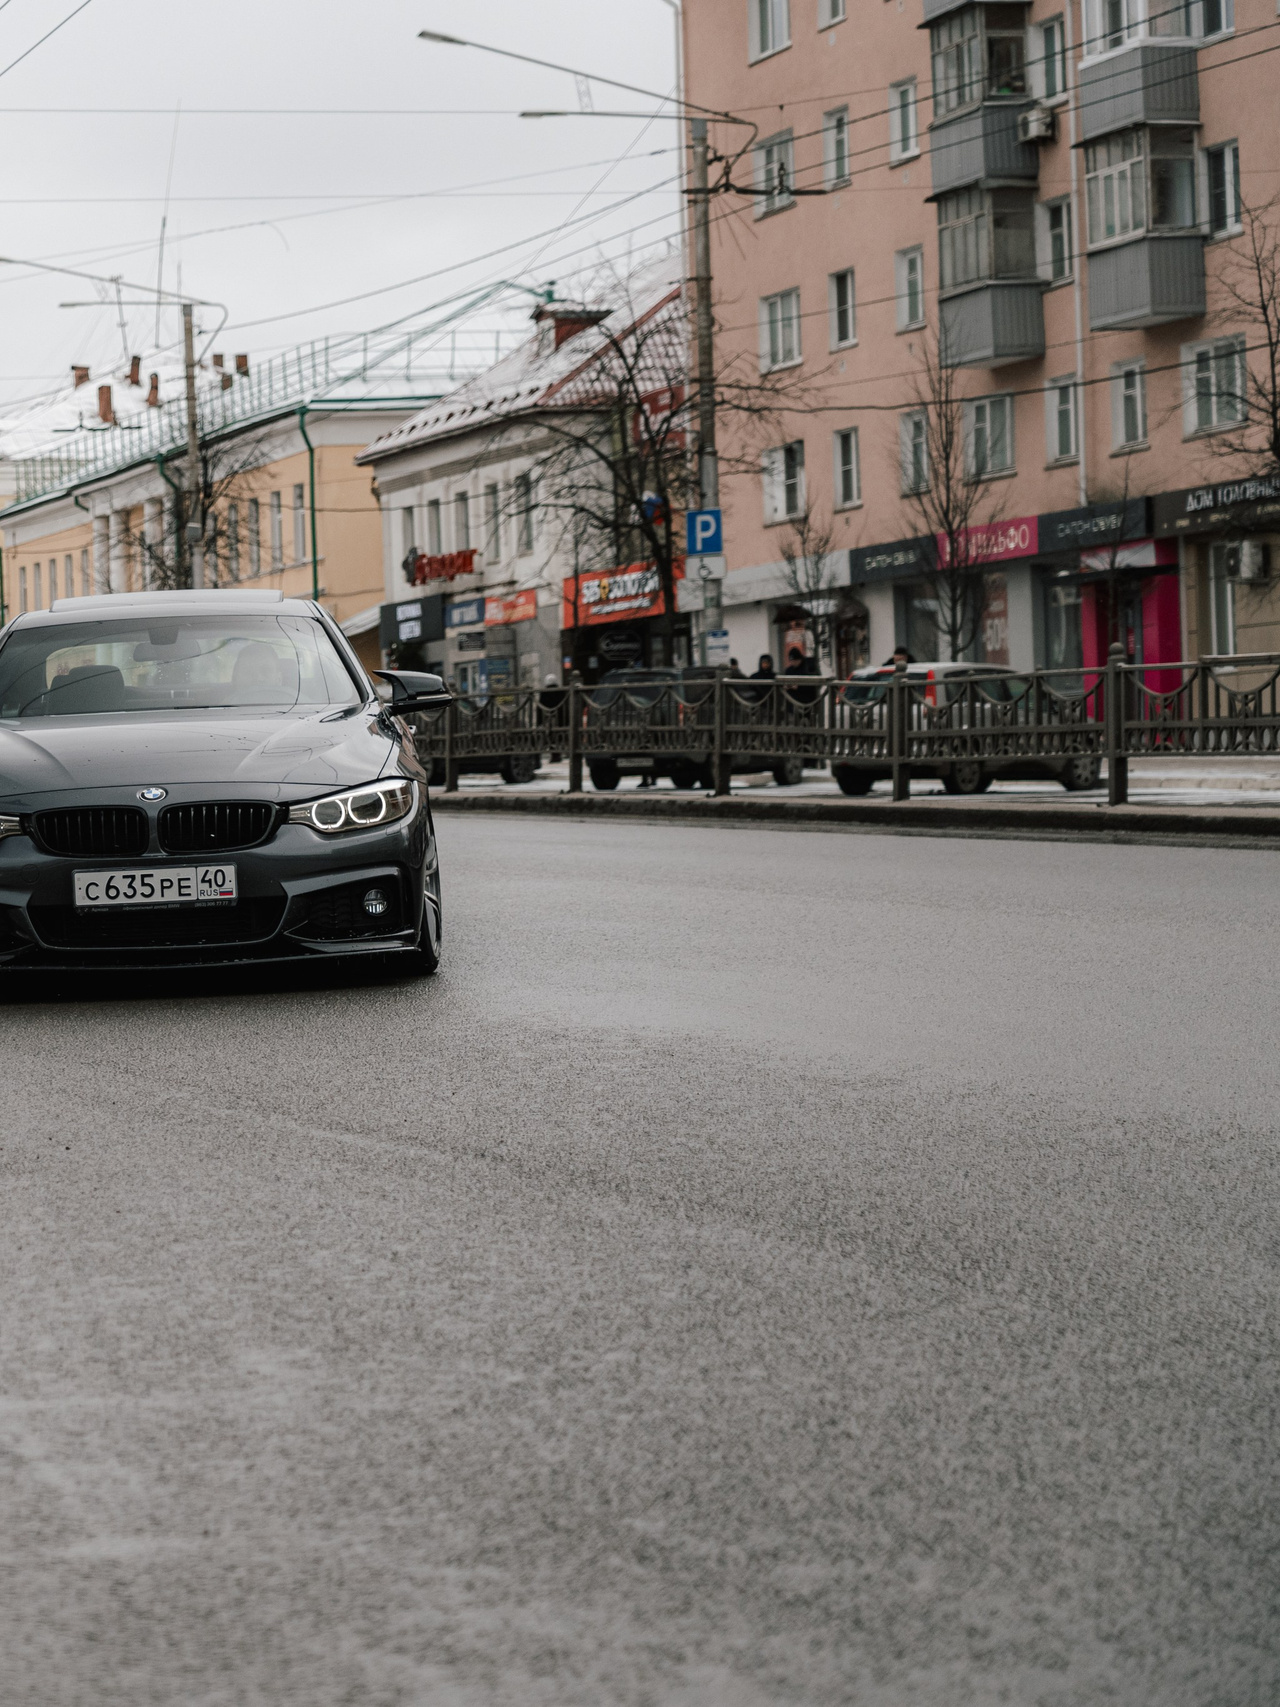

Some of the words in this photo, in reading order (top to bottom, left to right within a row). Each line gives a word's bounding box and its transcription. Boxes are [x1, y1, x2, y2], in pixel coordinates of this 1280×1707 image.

[1186, 489, 1214, 512] ДОМ
[696, 514, 717, 550] P
[200, 868, 226, 889] 40
[199, 889, 219, 897] RUS
